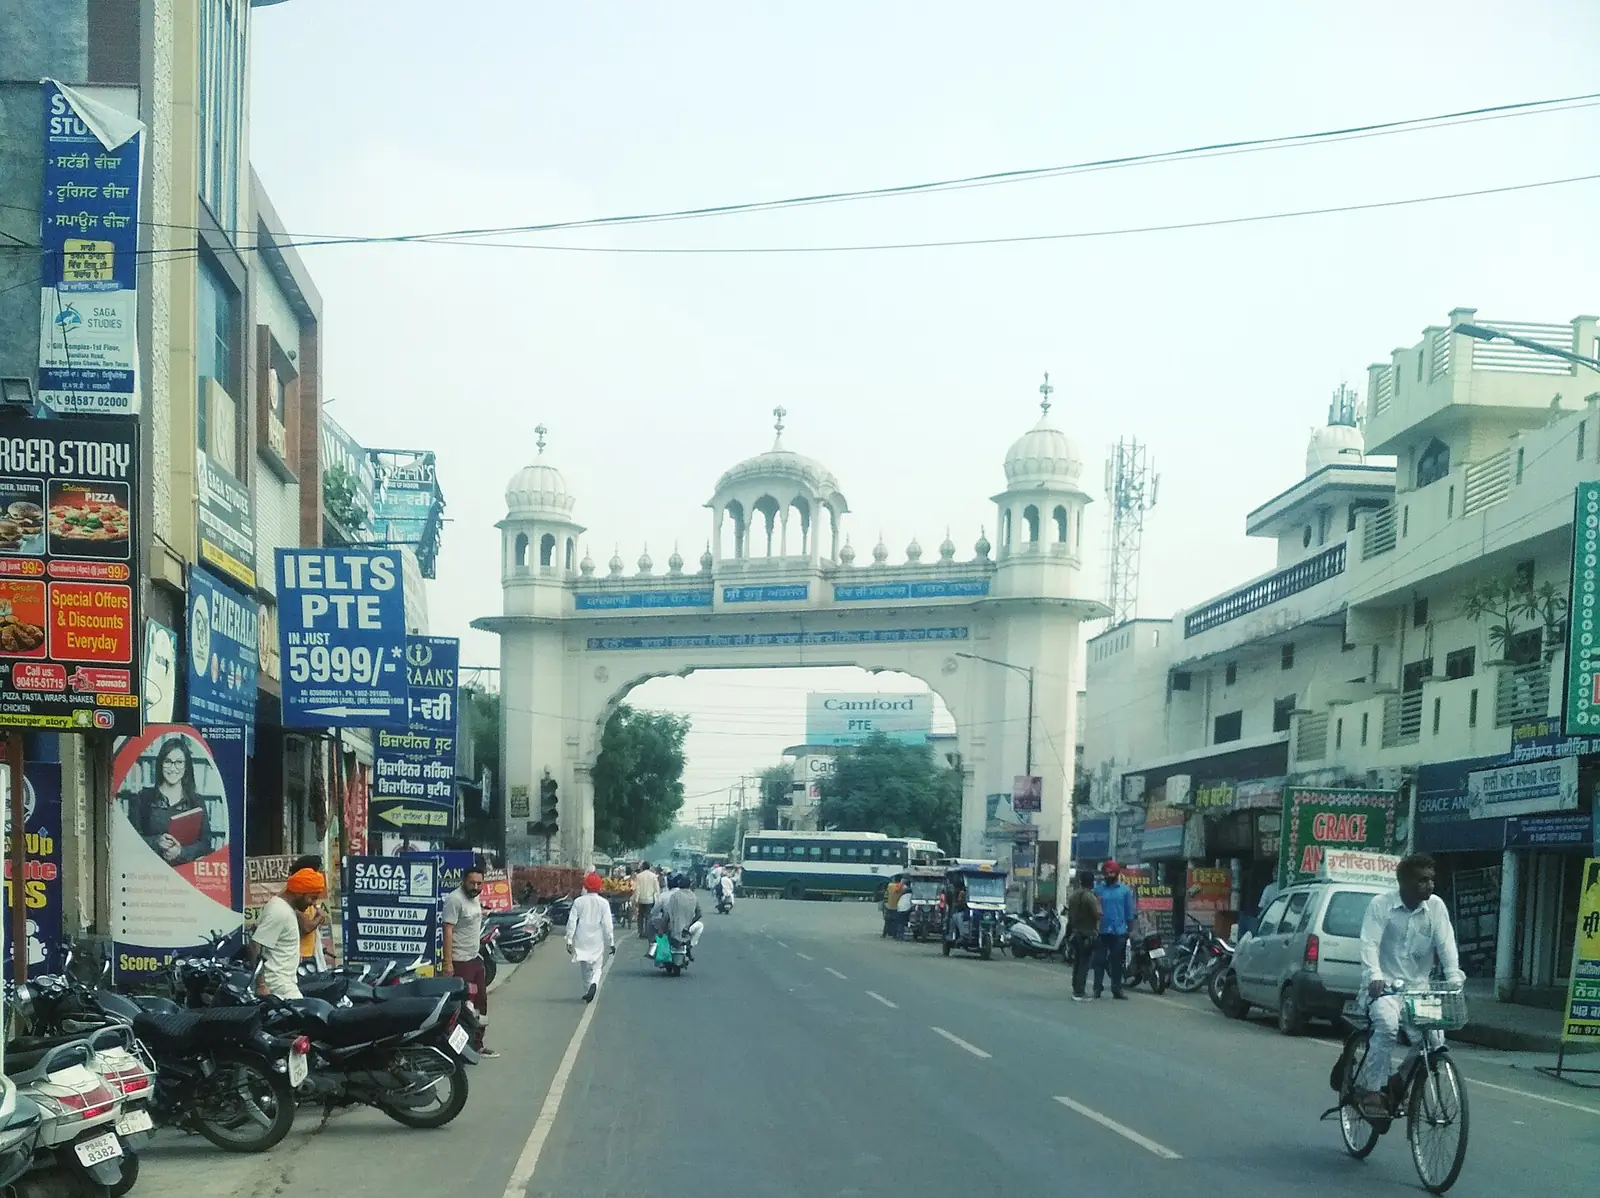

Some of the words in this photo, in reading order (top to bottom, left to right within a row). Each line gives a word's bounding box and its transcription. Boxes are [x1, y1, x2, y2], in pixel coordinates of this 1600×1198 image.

[57, 152, 90, 169] ਸਟੱਡੀ
[94, 153, 122, 169] ਵੀਜ਼ਾ
[56, 181, 98, 202] ਟੂਰਿਸਟ
[102, 182, 130, 199] ਵੀਜ਼ਾ
[102, 212, 131, 228] ਵੀਜ਼ਾ
[93, 308, 117, 317] SAGA
[87, 319, 122, 329] STUDIES
[64, 396, 94, 405] 98587
[98, 397, 128, 407] 02000
[59, 441, 130, 477] STORY
[85, 493, 116, 503] PIZZA
[283, 555, 396, 591] IELTS
[52, 589, 92, 607] Special
[95, 591, 128, 609] Offers
[301, 594, 382, 629] PTE
[57, 611, 66, 626] &
[69, 612, 124, 629] Discounts
[211, 588, 257, 651] EMERALD
[67, 632, 118, 654] Everyday
[288, 632, 300, 645] IN
[303, 632, 331, 645] JUST
[25, 666, 41, 676] Call
[42, 668, 54, 677] us:
[96, 680, 127, 688] zomato
[3, 704, 31, 712] CHICKEN
[97, 695, 137, 706] COFFEE
[824, 699, 914, 710] Camford
[848, 719, 872, 731] PTE
[435, 737, 453, 756] ਸੂਟ
[1418, 798, 1449, 814] GRACE
[1312, 812, 1367, 841] GRACE
[194, 861, 228, 877] IELTS
[355, 863, 406, 878] SAGA
[354, 878, 407, 891] STUDIES
[367, 908, 395, 917] STUDY
[398, 909, 418, 919] VISA
[362, 925, 399, 935] TOURIST
[402, 926, 422, 936] VISA
[362, 942, 398, 952] SPOUSE
[400, 943, 421, 952] VISA
[87, 1146, 116, 1162] 8382
